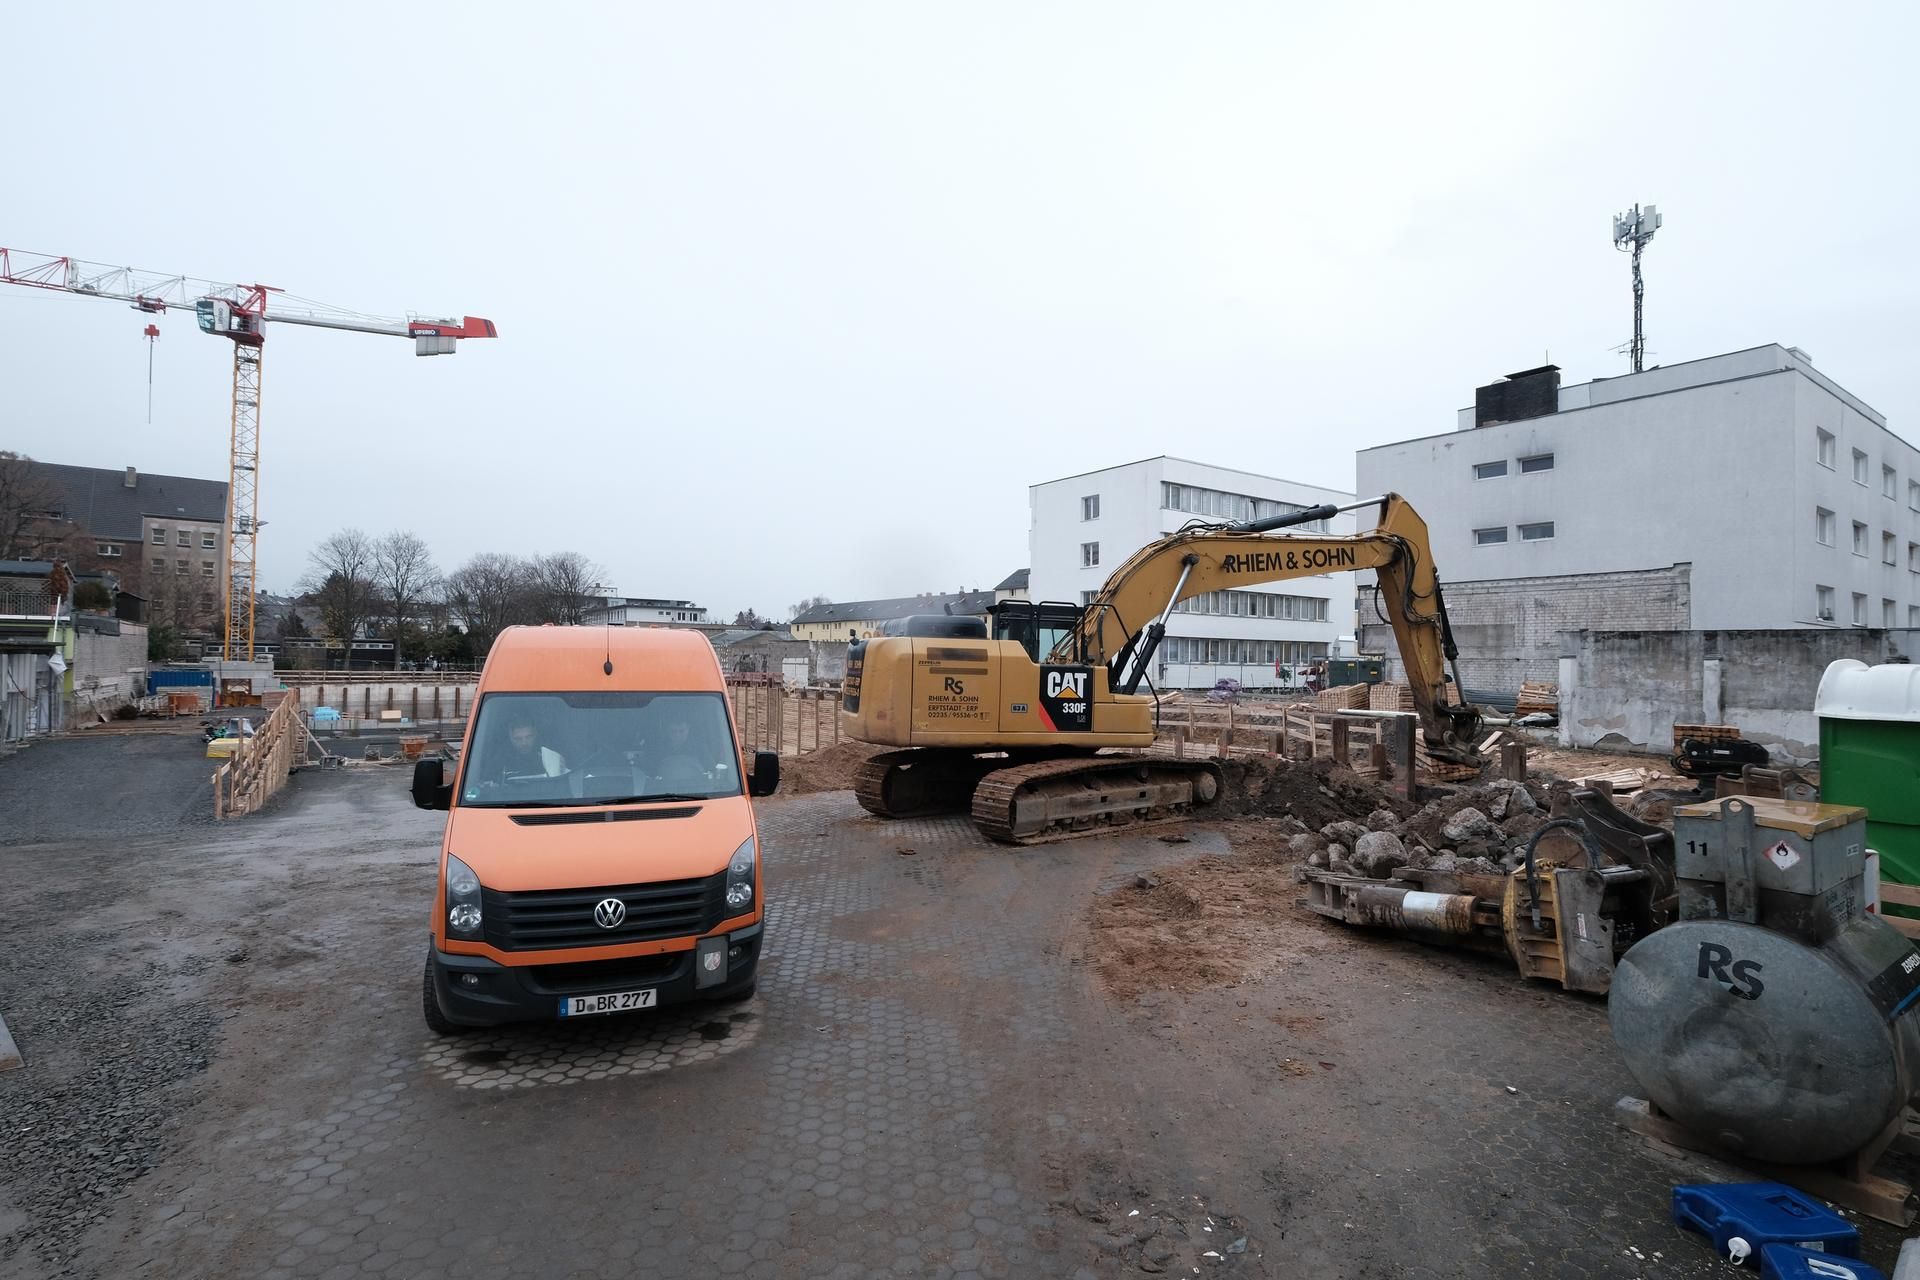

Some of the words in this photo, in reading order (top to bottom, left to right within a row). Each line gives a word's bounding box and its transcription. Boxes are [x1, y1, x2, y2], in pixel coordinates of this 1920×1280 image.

[1223, 552, 1282, 573] RHIEM
[1286, 551, 1299, 570] &
[1302, 547, 1356, 569] SOHN
[944, 676, 964, 695] RS
[1047, 671, 1087, 698] CAT
[1062, 702, 1087, 713] 330F
[1686, 840, 1708, 857] 11
[1697, 941, 1765, 1000] RS
[575, 998, 586, 1013] D
[597, 995, 617, 1011] BR
[621, 991, 651, 1008] 277
